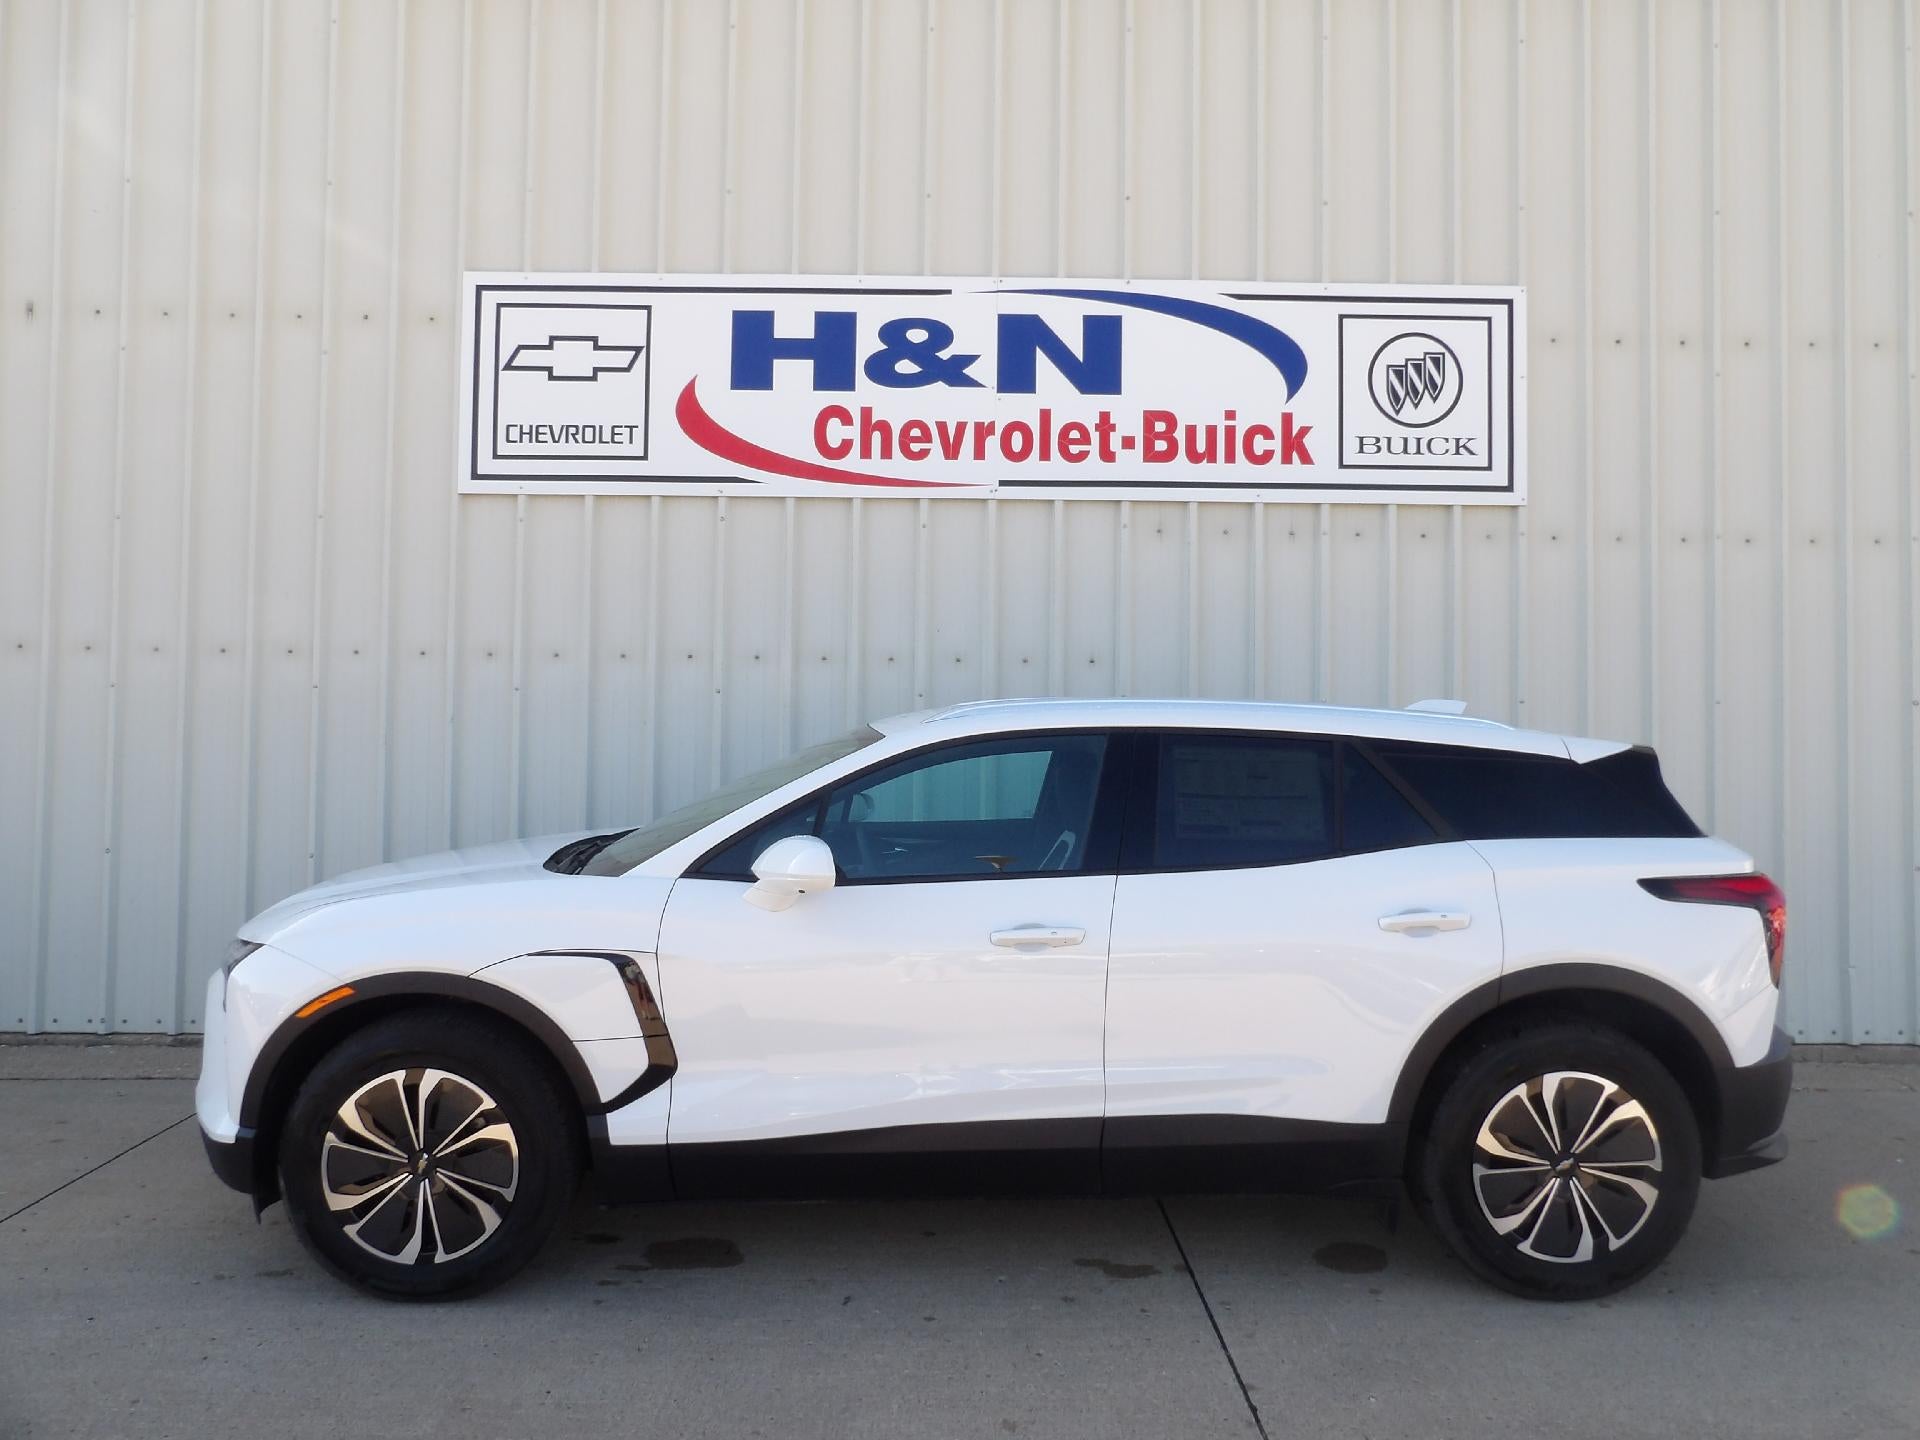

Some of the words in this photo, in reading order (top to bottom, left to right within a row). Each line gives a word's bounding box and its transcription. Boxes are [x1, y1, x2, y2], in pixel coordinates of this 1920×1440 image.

[731, 310, 1123, 395] H&N
[505, 424, 639, 445] CHEVROLET
[813, 404, 1315, 466] Chevrolet-Buick
[1355, 435, 1478, 456] BUICK
